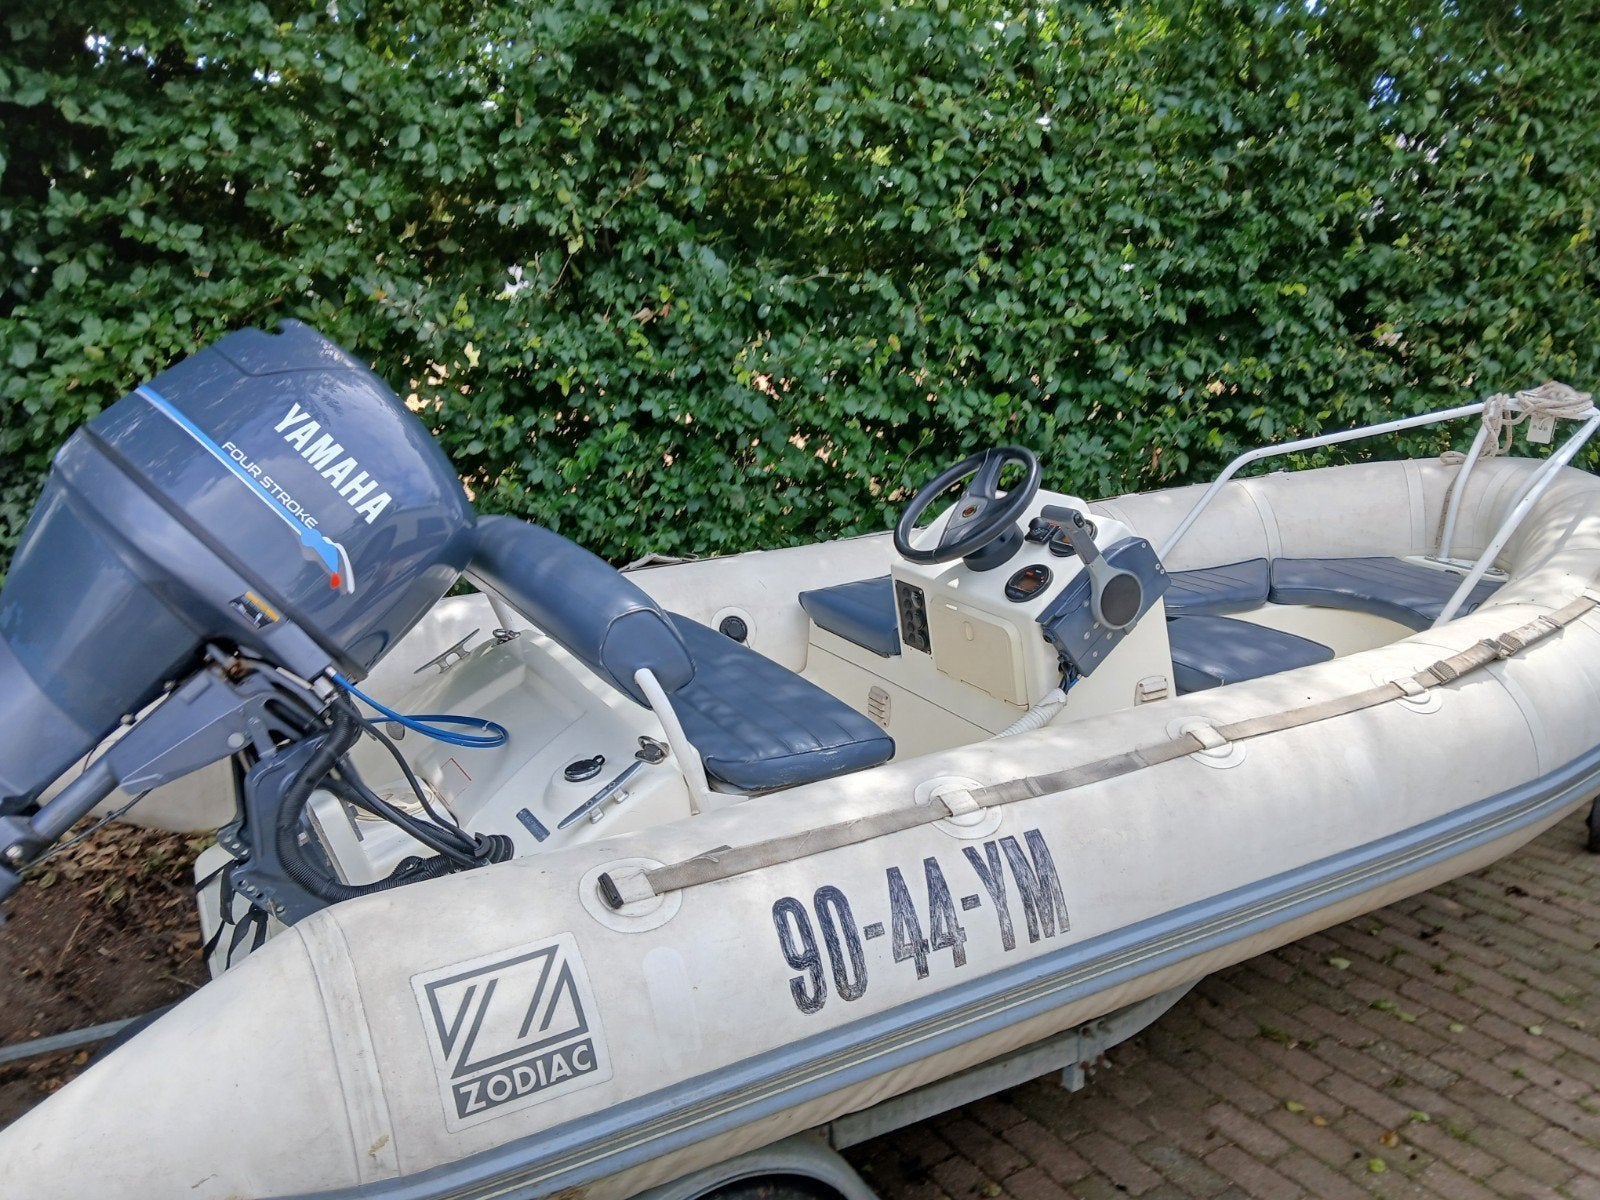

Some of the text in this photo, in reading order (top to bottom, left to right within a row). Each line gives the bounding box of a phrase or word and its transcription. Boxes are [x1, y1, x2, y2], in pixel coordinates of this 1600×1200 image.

[222, 441, 319, 530] FOUR STROKE
[274, 402, 392, 525] YAMAHA
[772, 828, 1070, 1015] 90-44-YM
[459, 1044, 592, 1114] ZODIAC
